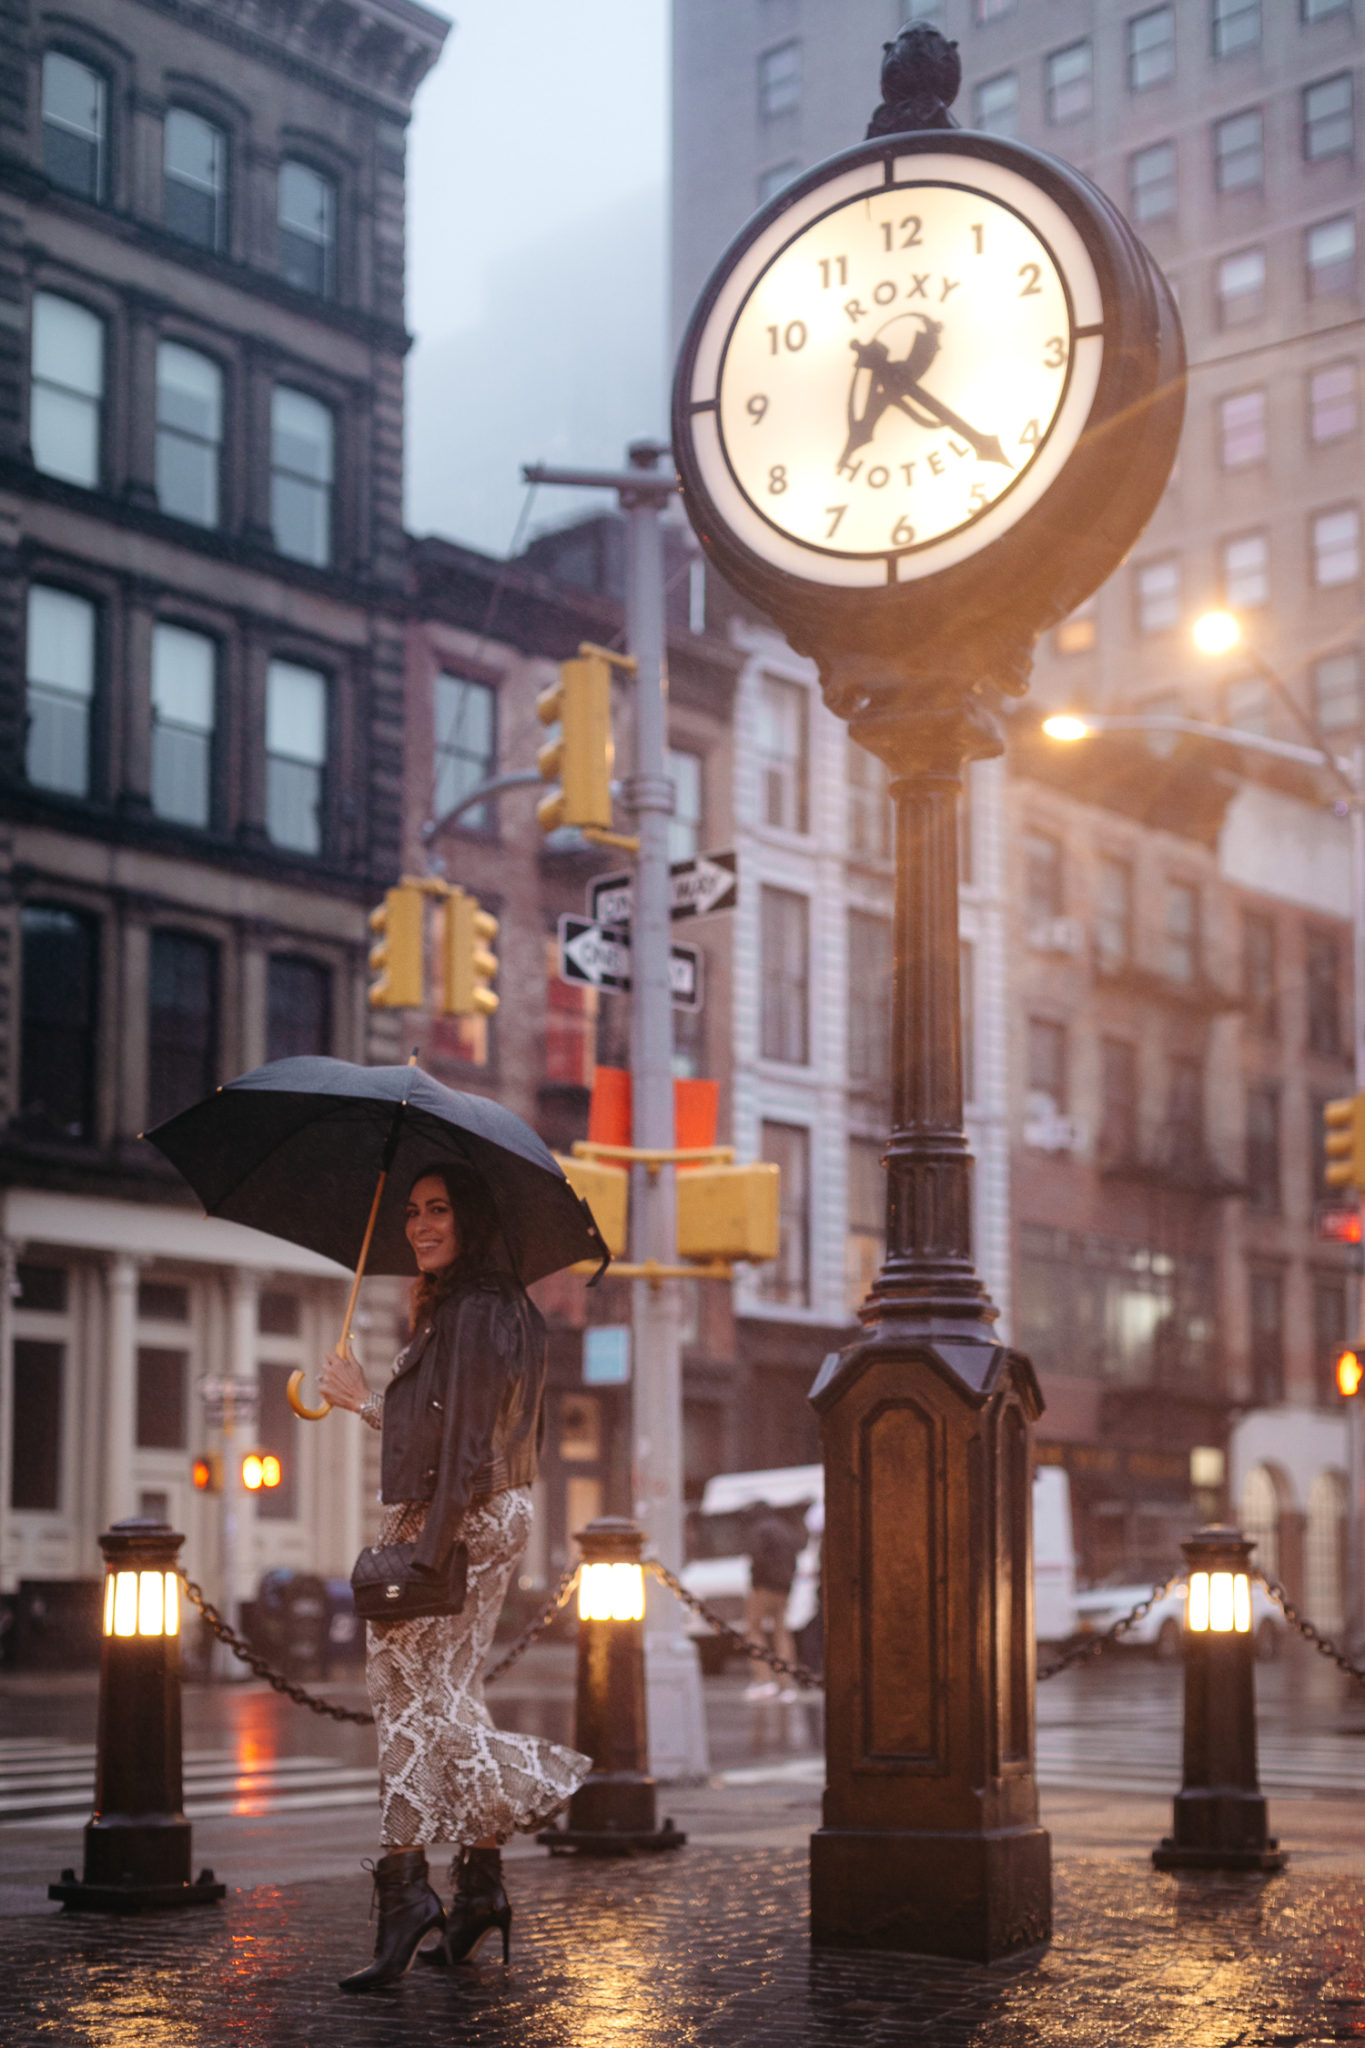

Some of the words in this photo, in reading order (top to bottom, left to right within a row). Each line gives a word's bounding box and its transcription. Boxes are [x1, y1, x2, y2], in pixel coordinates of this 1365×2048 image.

[880, 215, 923, 251] 12
[970, 223, 985, 255] 1
[817, 255, 849, 290] 11
[1017, 262, 1043, 297] 2
[843, 273, 960, 324] ROXY
[766, 320, 808, 356] 10
[1043, 336, 1068, 370] 3
[746, 394, 769, 425] 9
[1018, 418, 1043, 453] 4
[767, 464, 788, 495] 8
[837, 437, 971, 490] HOTEL
[967, 482, 989, 518] 5
[823, 503, 849, 539] 7
[890, 515, 916, 548] 6
